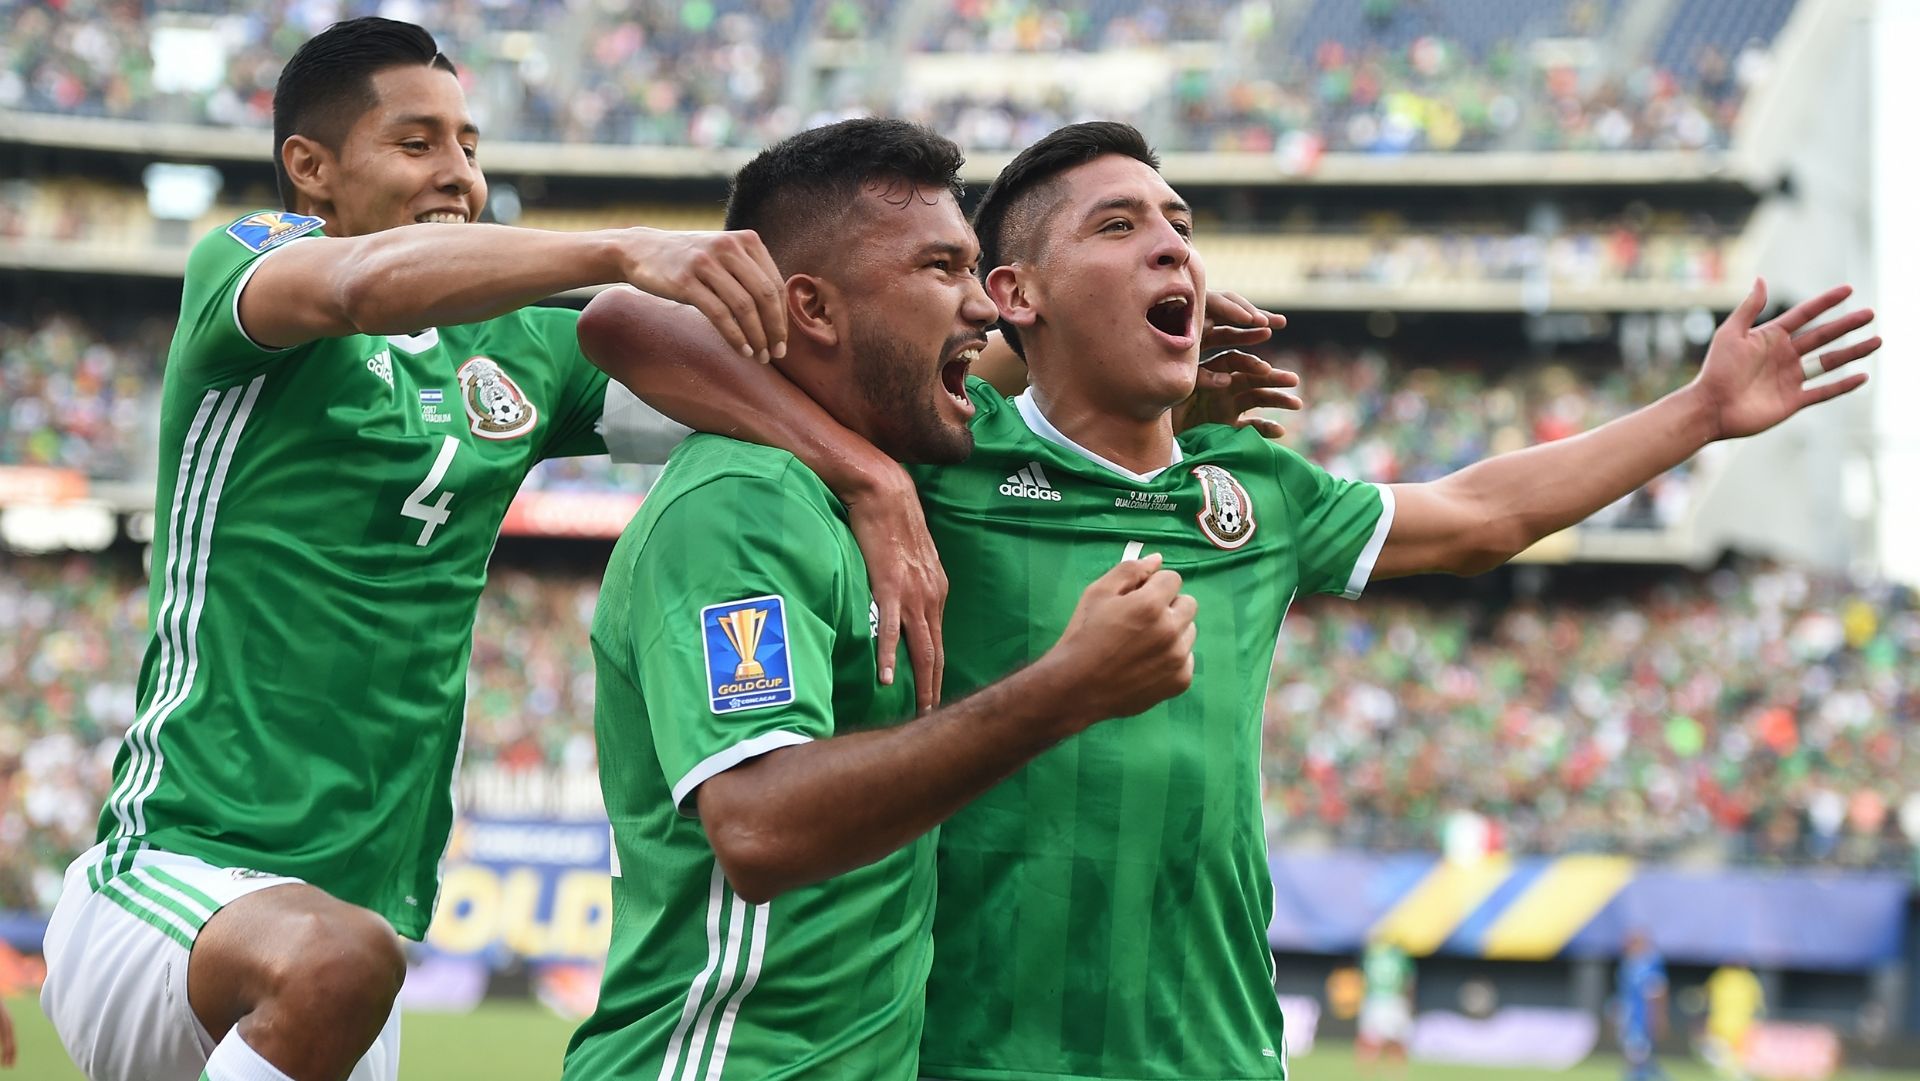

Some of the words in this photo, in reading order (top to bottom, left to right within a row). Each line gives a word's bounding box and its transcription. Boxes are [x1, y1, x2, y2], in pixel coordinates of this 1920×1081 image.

[400, 434, 460, 547] 4
[999, 483, 1062, 502] adidas
[1130, 491, 1136, 500] 9
[1136, 492, 1153, 502] JULY
[1153, 494, 1169, 504] 2017
[1115, 497, 1151, 509] QUALCOMM
[1150, 503, 1178, 511] STADIUM
[718, 682, 755, 695] GOLD
[755, 678, 783, 689] CUP
[741, 695, 777, 705] CONCACAF
[424, 865, 613, 958] OLD
